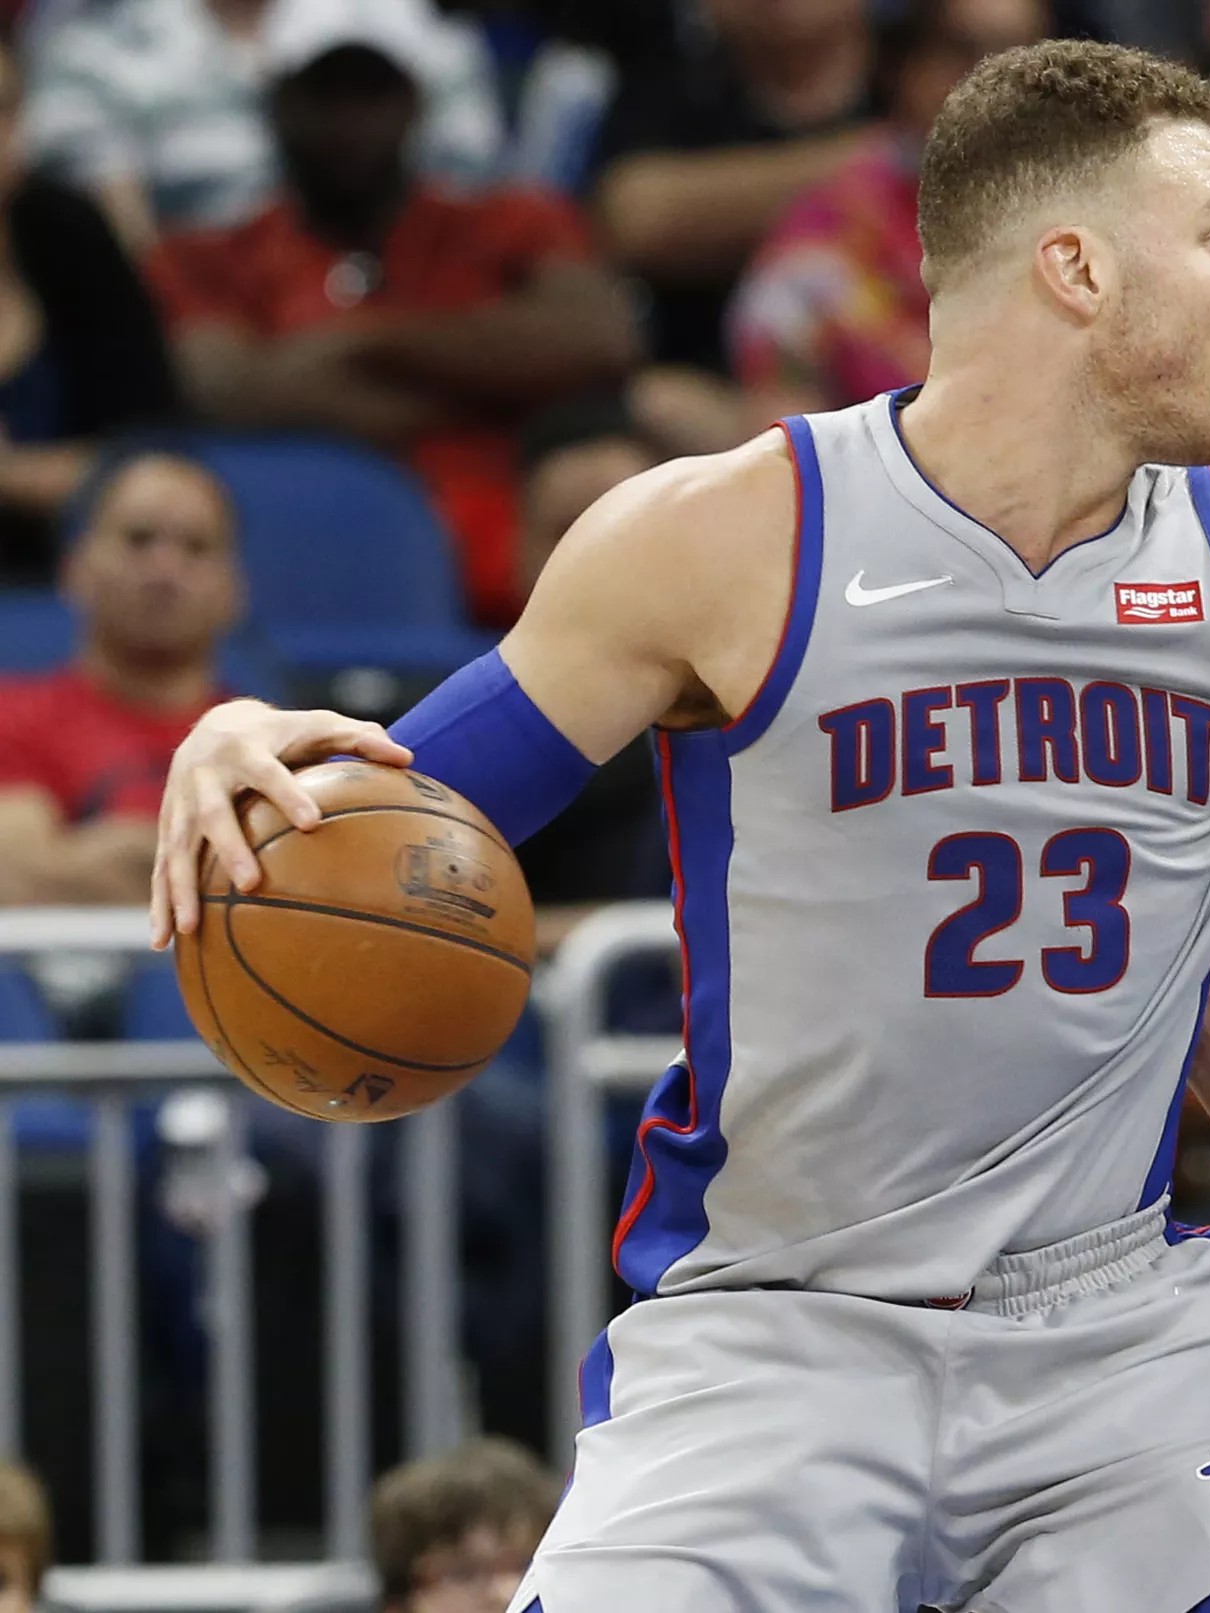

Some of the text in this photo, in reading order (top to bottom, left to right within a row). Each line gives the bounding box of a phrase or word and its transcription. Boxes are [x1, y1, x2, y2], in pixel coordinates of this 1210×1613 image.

[1119, 588, 1197, 609] Flagstar
[1168, 606, 1198, 618] Bank
[924, 826, 1132, 998] 23
